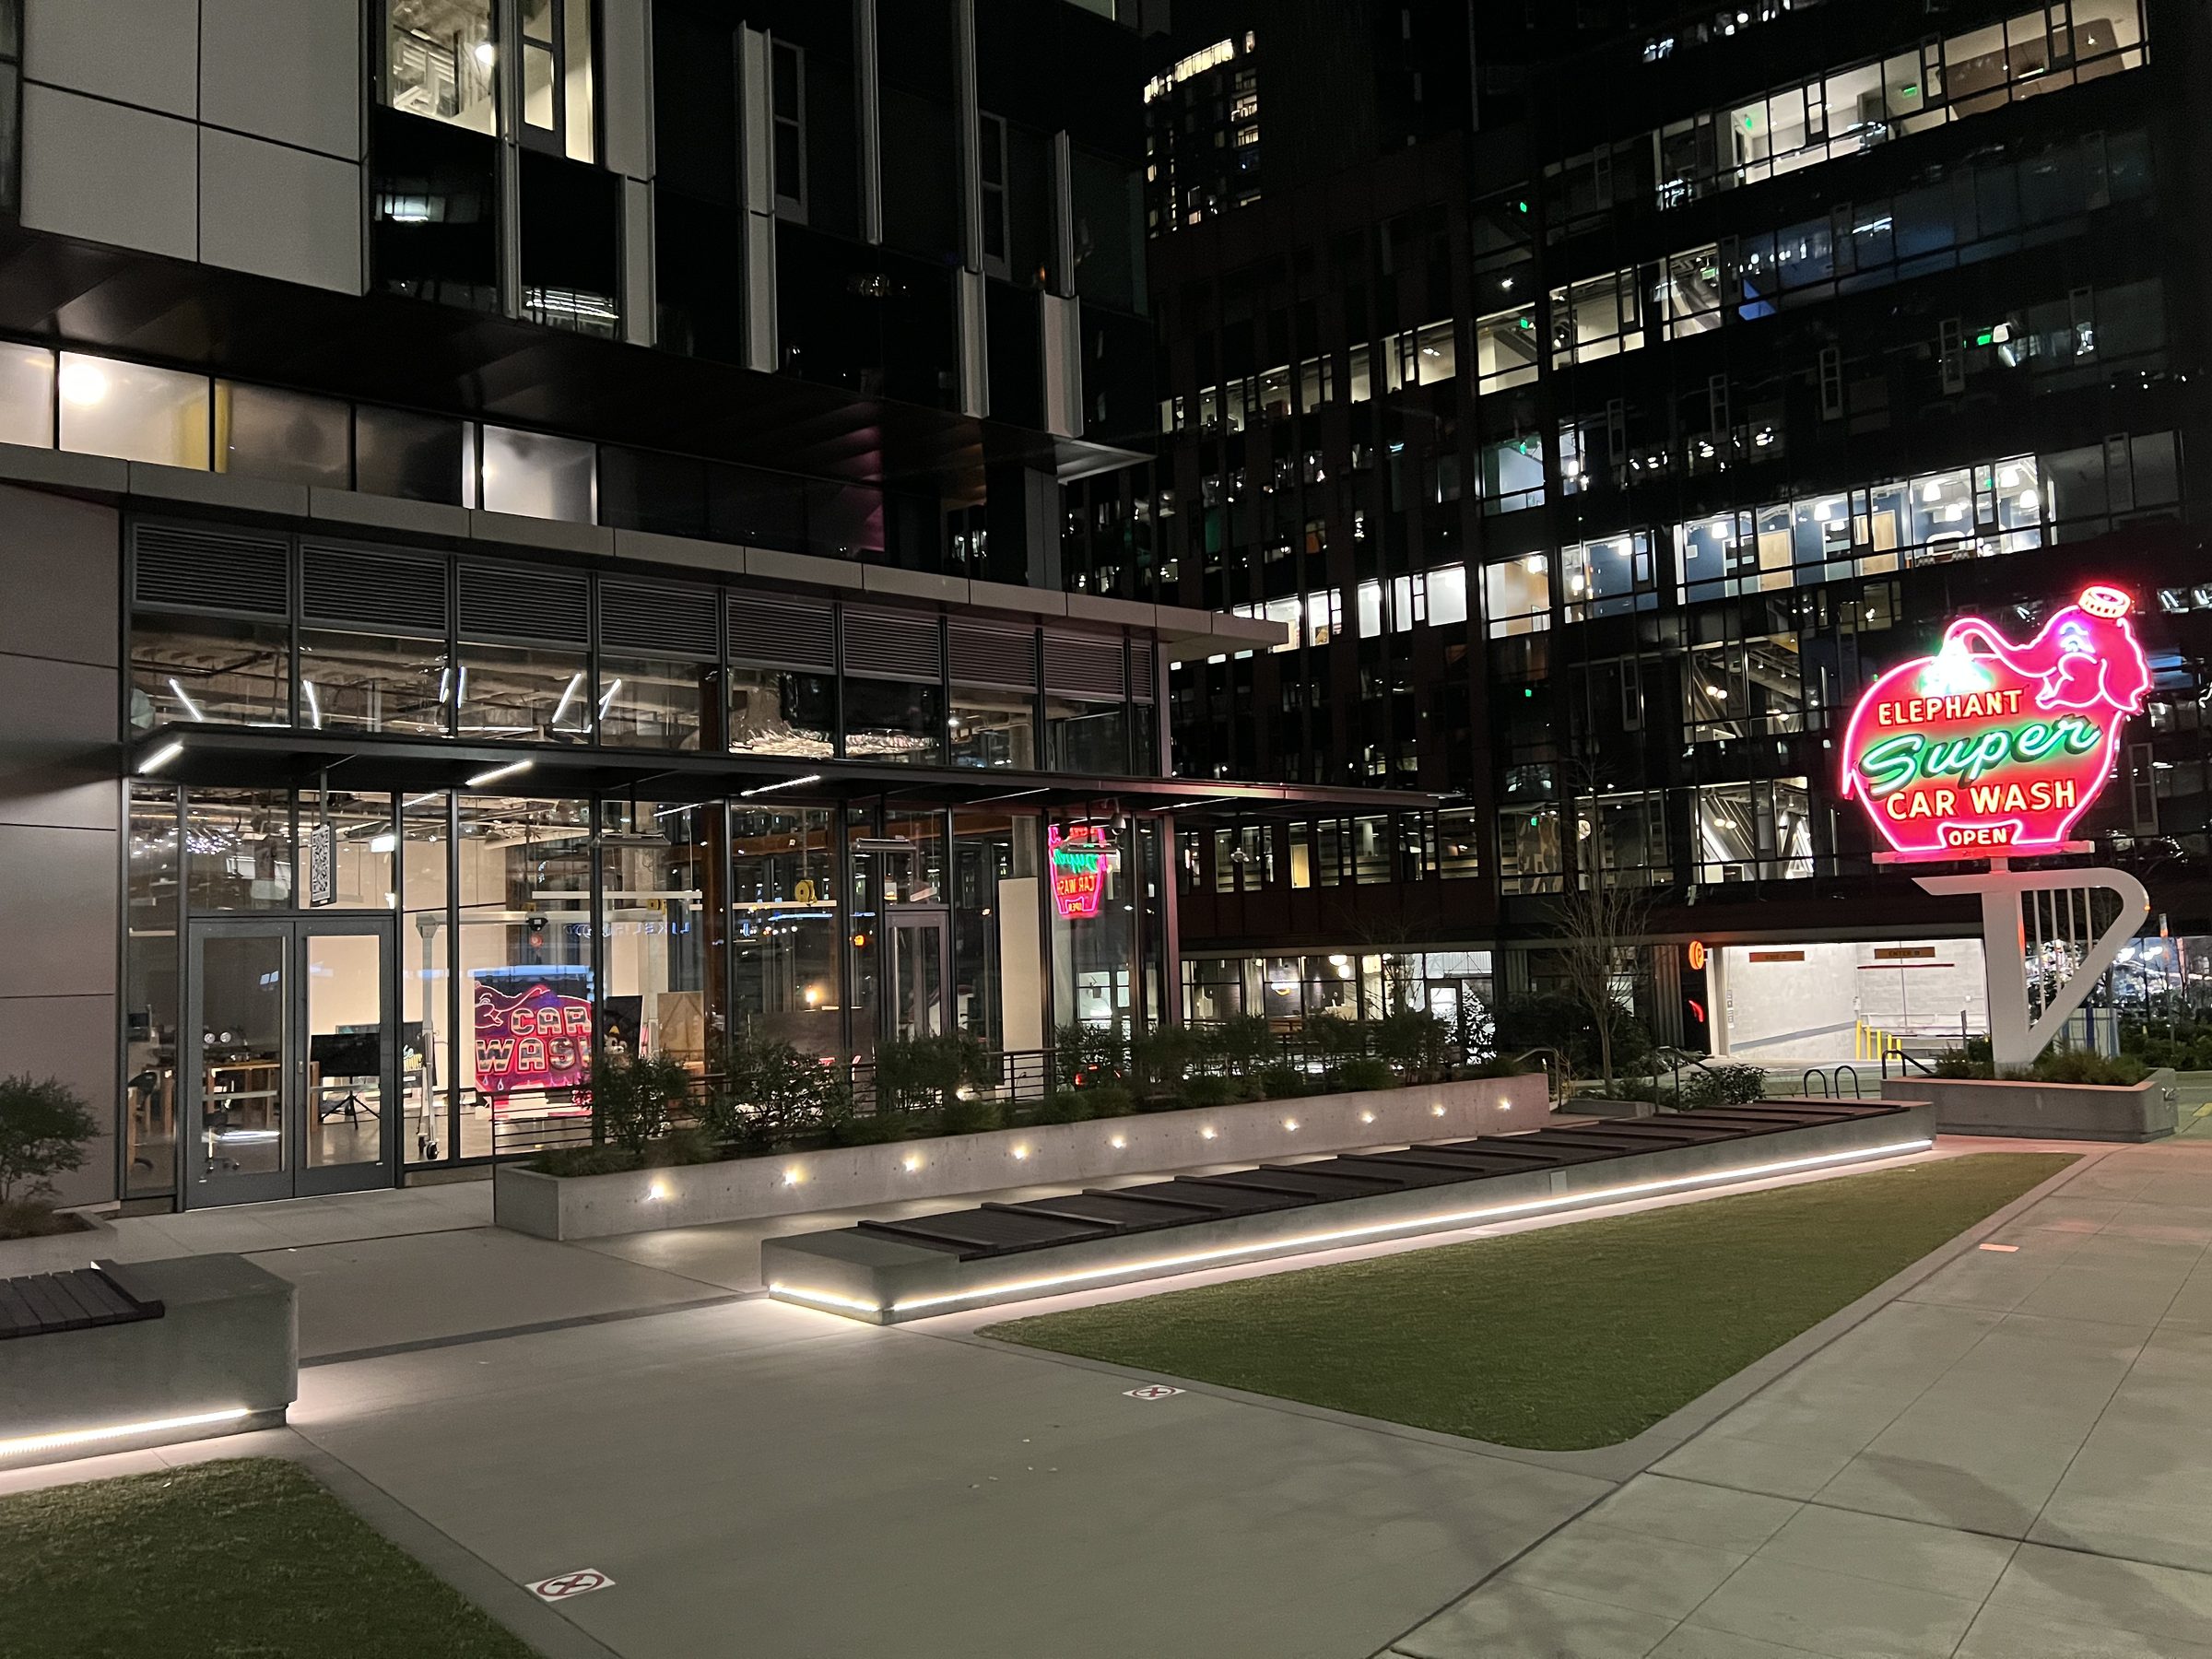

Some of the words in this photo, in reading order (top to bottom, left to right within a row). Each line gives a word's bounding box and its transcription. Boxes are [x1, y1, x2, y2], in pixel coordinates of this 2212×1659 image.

[1877, 689, 2023, 725] ELEPHANT
[1860, 715, 2102, 798] Super
[1886, 791, 1956, 820] CAR
[1971, 780, 2076, 815] WASH
[1948, 829, 2008, 846] OPEN
[509, 1006, 592, 1036] CAR
